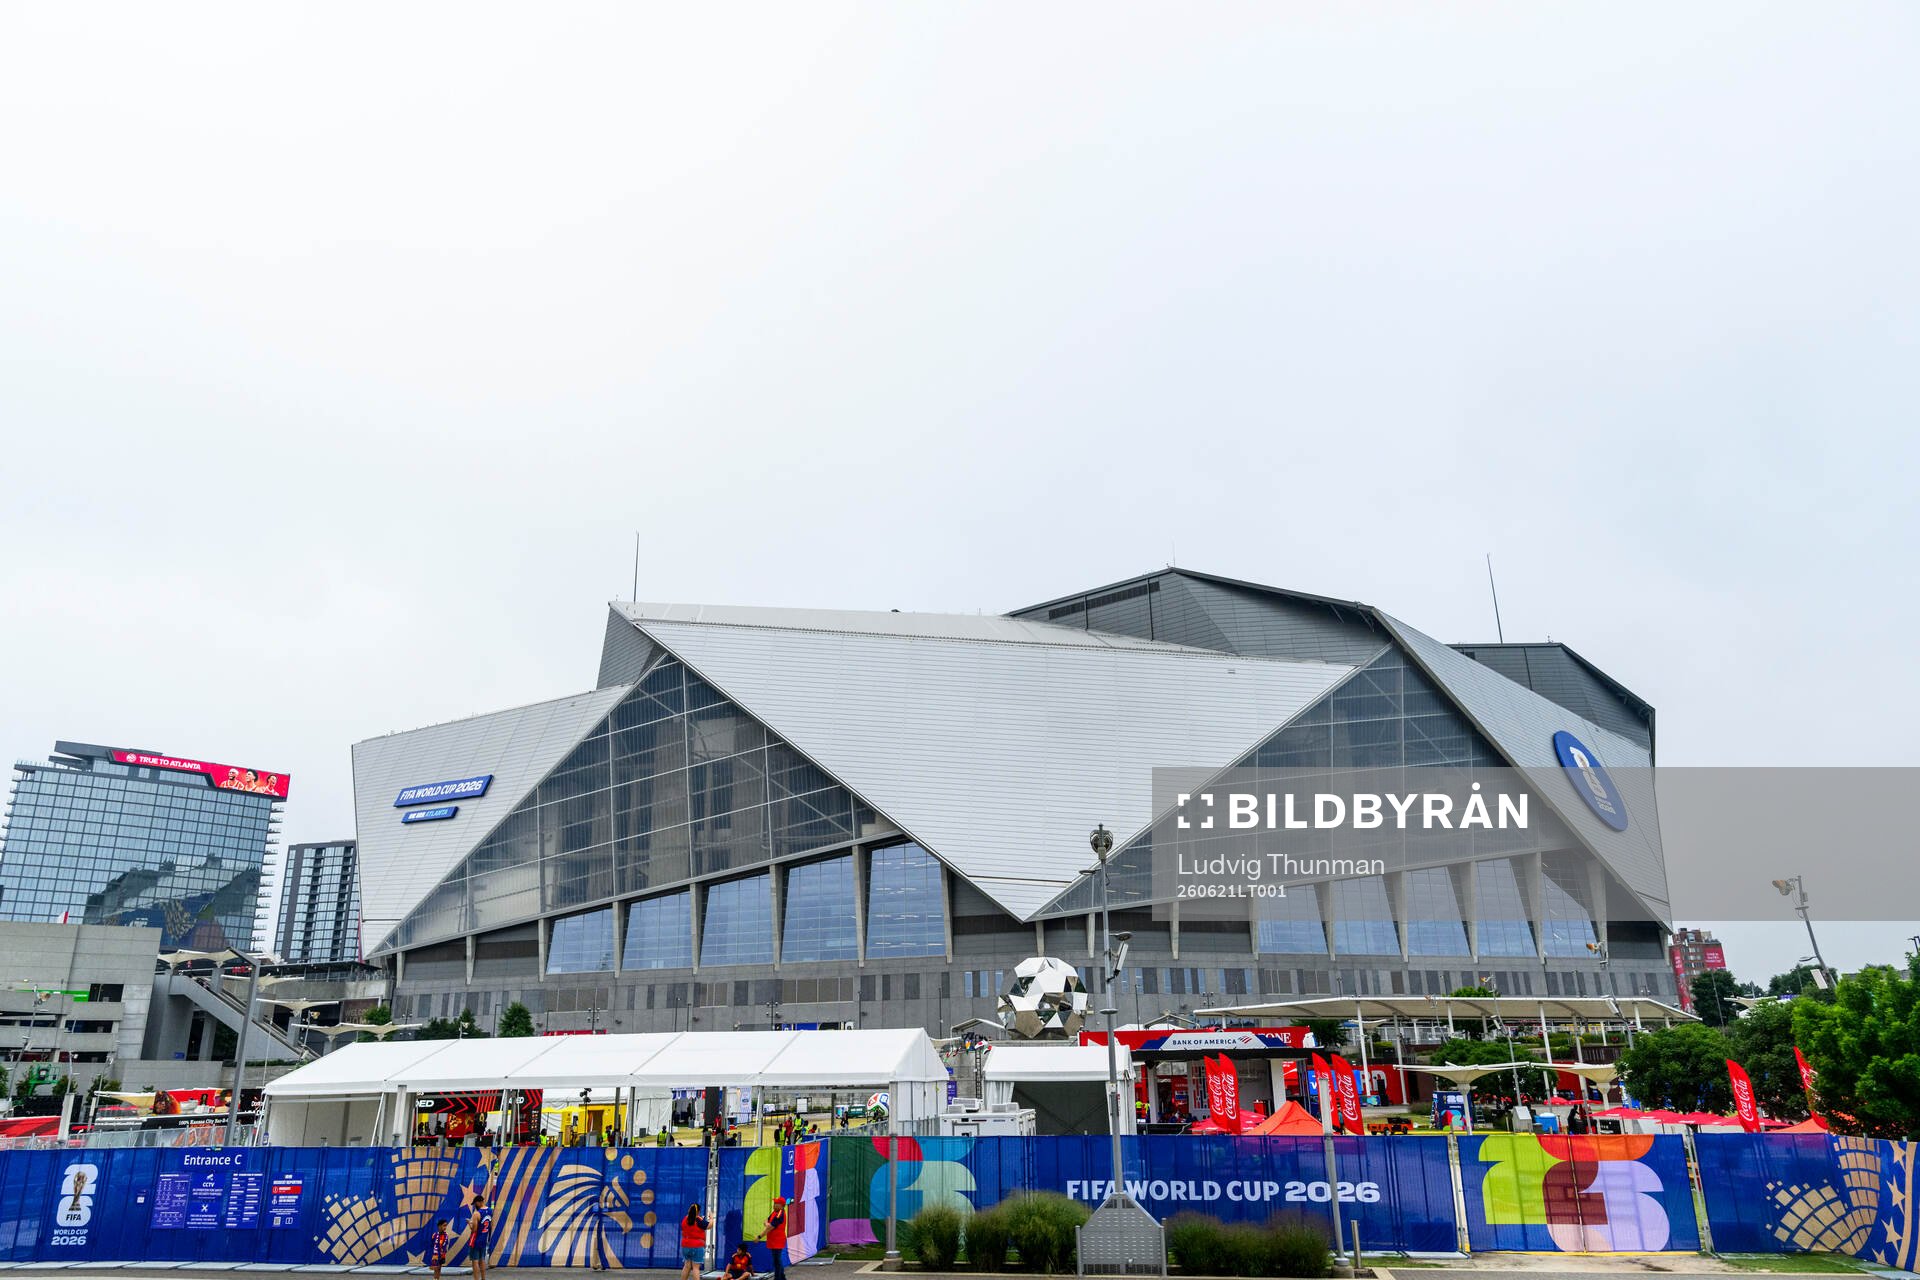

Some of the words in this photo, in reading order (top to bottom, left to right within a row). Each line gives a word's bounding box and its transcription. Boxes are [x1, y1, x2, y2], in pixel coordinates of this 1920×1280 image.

[139, 756, 158, 765] TRUE
[159, 758, 170, 766] TO
[169, 760, 201, 770] ATLANTA
[400, 789, 416, 801] FIFA
[415, 786, 441, 798] WORLD
[440, 783, 456, 795] CUP
[455, 780, 484, 793] 2026
[425, 808, 449, 817] ATLANTA
[1209, 1074, 1224, 1115] Coca-Cola
[1221, 1072, 1237, 1120] Coca-Cola
[1338, 1073, 1359, 1121] Coca-Cola
[1733, 1078, 1755, 1122] Coca-Cola
[183, 1154, 231, 1166] Entrance
[234, 1154, 242, 1165] C
[1066, 1180, 1118, 1200] FIFA
[1122, 1180, 1221, 1201] WORLD
[1226, 1180, 1280, 1202] CUP
[1284, 1181, 1381, 1203] 2026
[66, 1213, 82, 1221] FIFA
[53, 1228, 75, 1236] WORLD
[481, 1220, 489, 1233] 2
[51, 1235, 87, 1246] 2026
